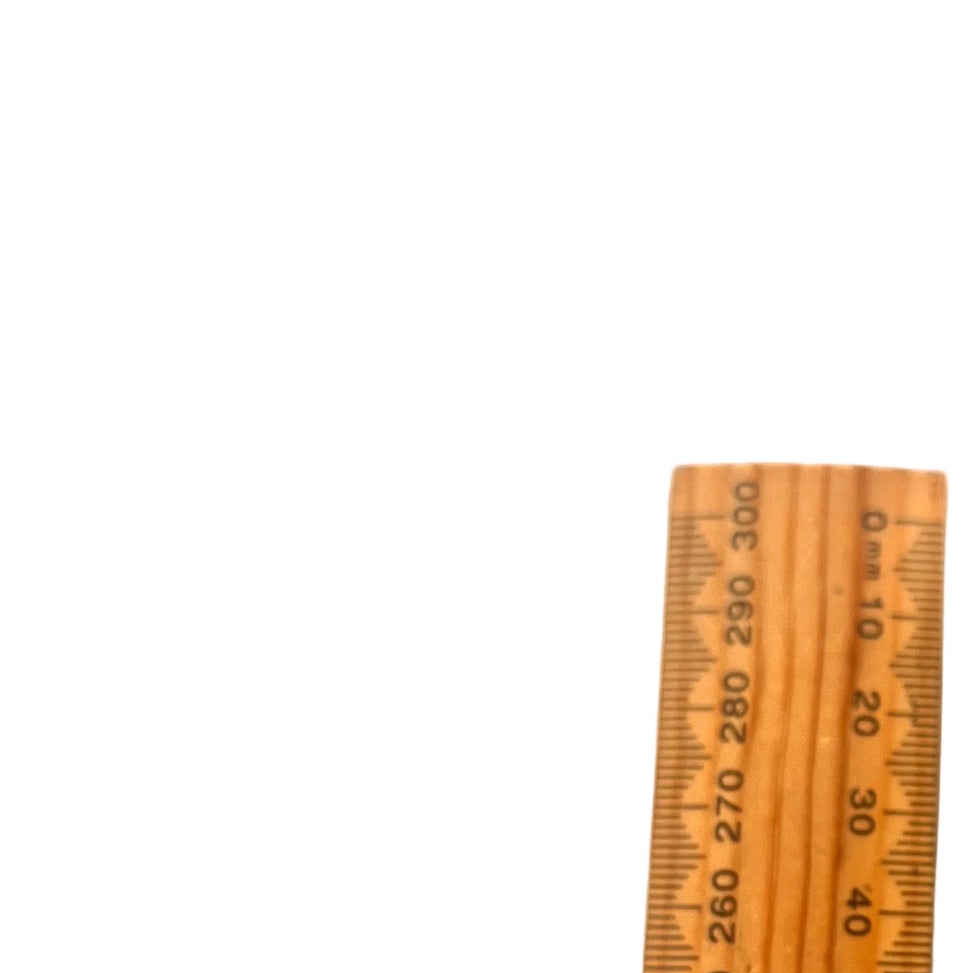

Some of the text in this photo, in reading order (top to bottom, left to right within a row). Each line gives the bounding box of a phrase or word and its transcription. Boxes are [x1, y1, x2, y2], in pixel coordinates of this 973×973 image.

[729, 480, 760, 552] 300
[861, 510, 888, 581] 0 mm
[725, 574, 756, 648] 290
[856, 597, 884, 641] 10
[720, 669, 751, 745] 280
[852, 690, 881, 738] 20
[714, 767, 745, 844] 270
[848, 788, 877, 837] 30
[709, 867, 740, 945] 260
[844, 886, 873, 938] 40
